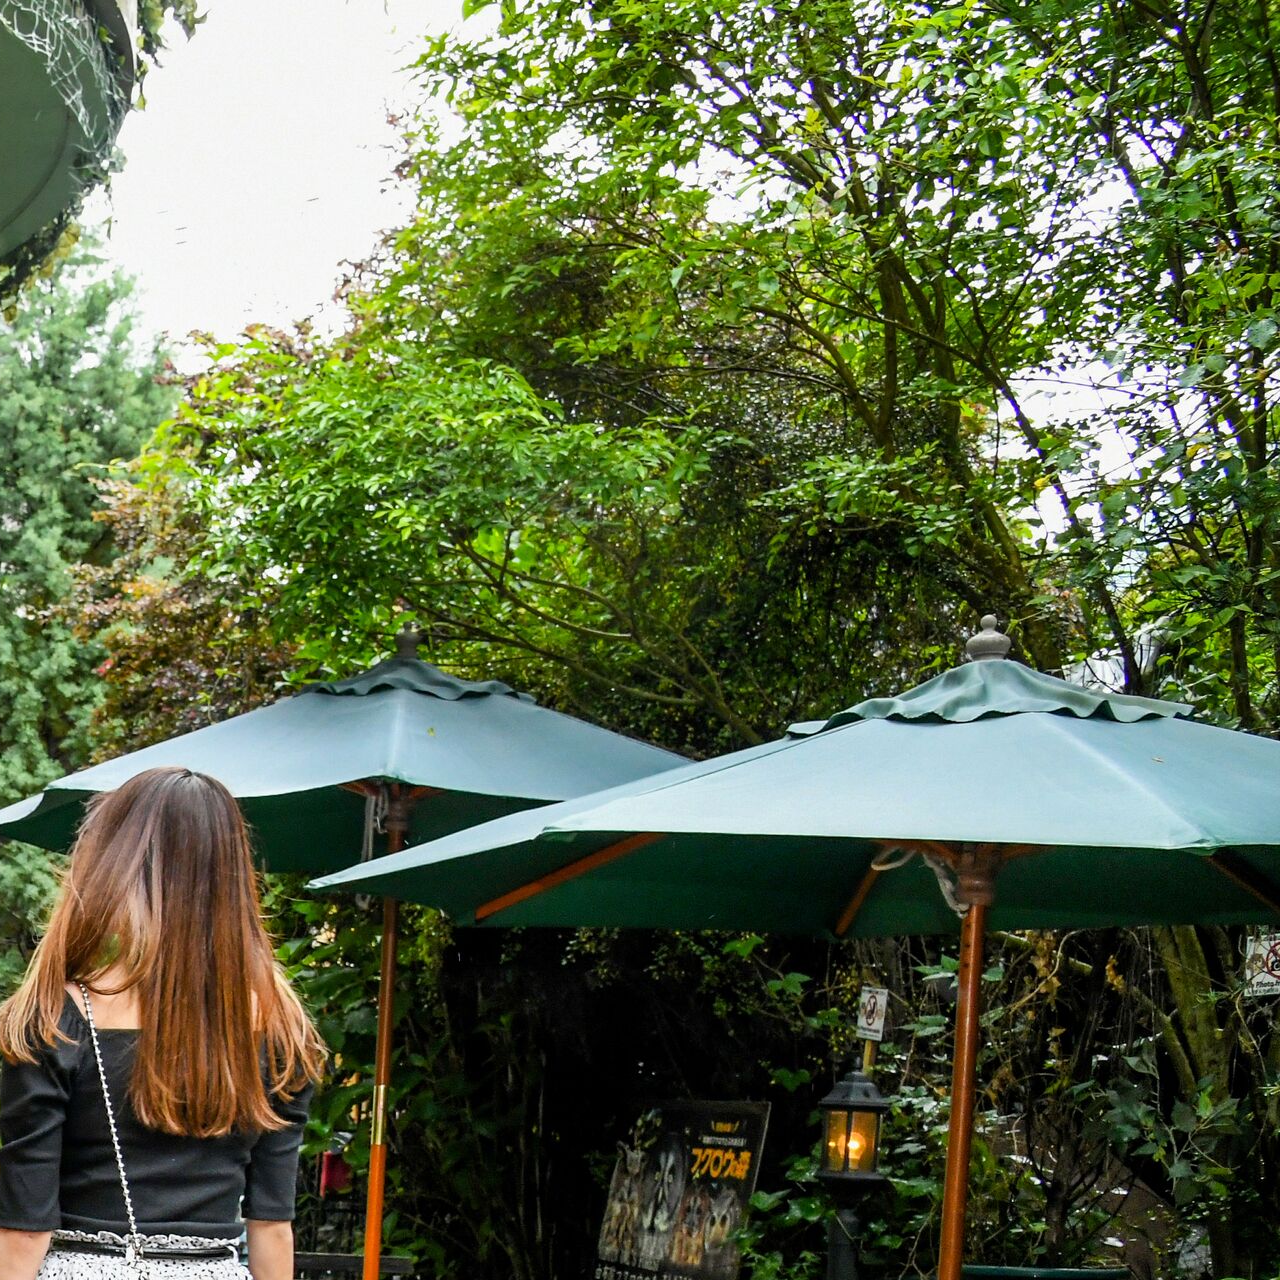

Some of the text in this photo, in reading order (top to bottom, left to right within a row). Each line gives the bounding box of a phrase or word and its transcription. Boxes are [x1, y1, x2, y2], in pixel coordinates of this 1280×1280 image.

[690, 1148, 752, 1180] フクロウの森
